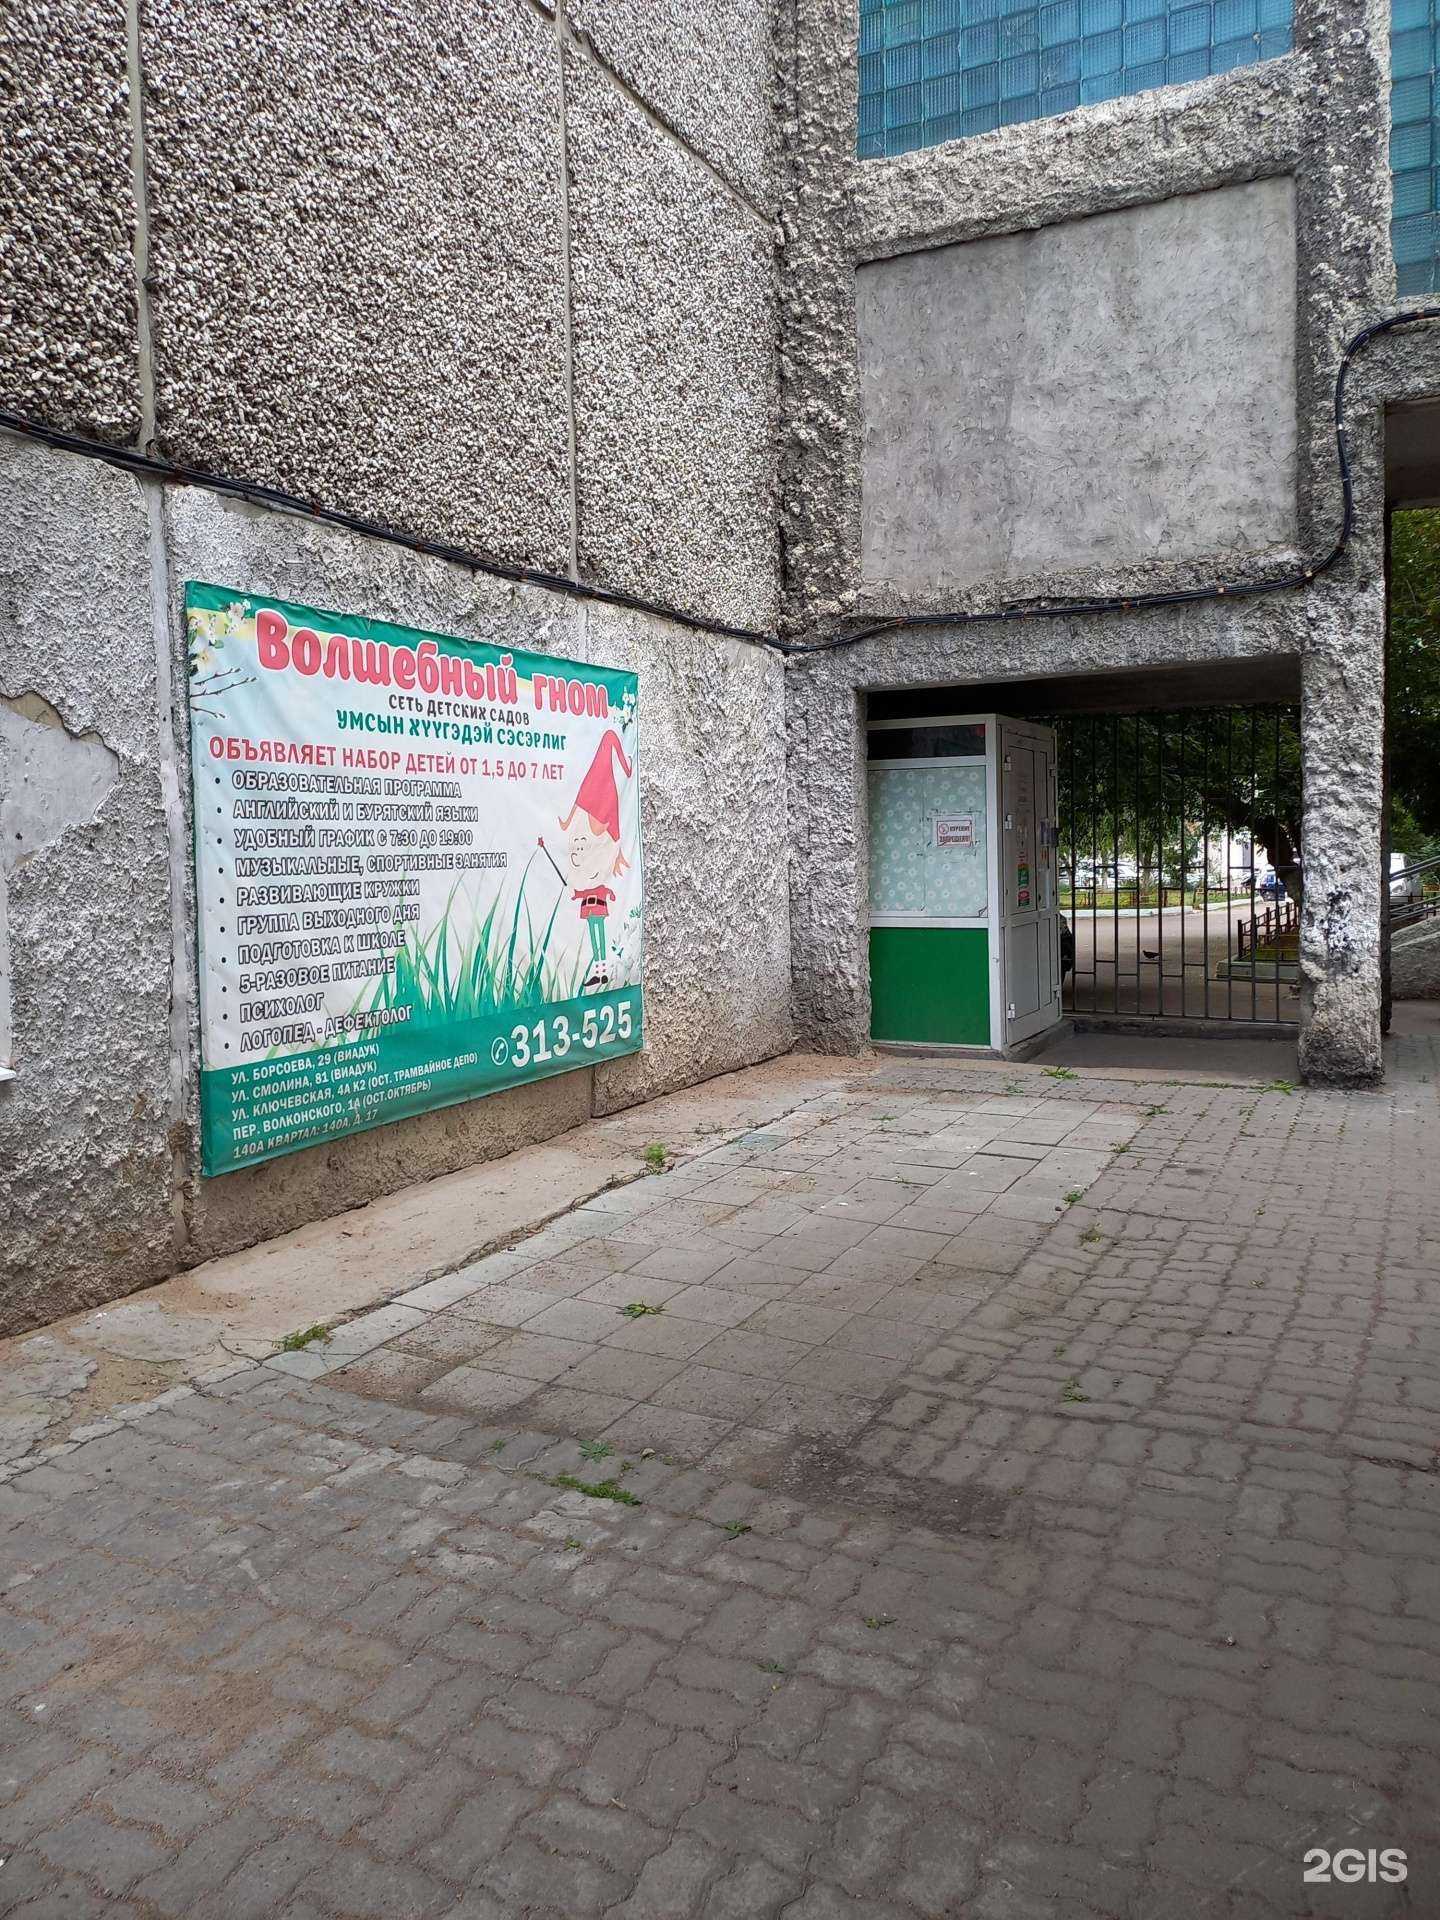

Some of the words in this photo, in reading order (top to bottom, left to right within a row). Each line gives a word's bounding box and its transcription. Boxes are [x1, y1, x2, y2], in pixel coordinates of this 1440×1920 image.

[255, 608, 518, 705] Волшебный
[532, 672, 609, 720] гном
[336, 709, 404, 735] УМСЫН
[497, 728, 566, 751] СЭСЭРЛИГ
[389, 694, 423, 712] СЕТЬ
[427, 699, 487, 721] ДЕТСКИХ
[490, 708, 530, 727] САДОВ
[209, 736, 336, 766] ОБЪЯВЛЯЕТ
[343, 748, 400, 770] НАБОР
[405, 752, 455, 774] ДЕТЕЙ
[460, 757, 477, 775] ОТ
[482, 758, 504, 779] 1,5
[508, 761, 526, 780] ДО
[531, 763, 538, 779] 7
[542, 764, 564, 780] ЛЕТ
[232, 770, 381, 795] ОБРАЗОВАТЕЛЬНАЯ
[384, 779, 462, 798] ПРОГРАММА
[233, 797, 340, 820] АНГЛИЙСКИЙ
[343, 803, 353, 820] И
[357, 802, 433, 821] БУРЯТСКИЙ
[436, 806, 479, 822] ЯЗЫКИ
[233, 825, 315, 851] УДОБНЫЙ
[319, 829, 374, 847] ГРАФИК
[377, 829, 387, 846] С
[389, 829, 418, 846] 7:30
[420, 829, 437, 848] ДО
[440, 829, 473, 846] 19:00
[235, 855, 363, 877] МУЗЫКАЛЬНЫЕ,
[366, 853, 454, 872] СПОРТИВНЫЕ
[456, 852, 507, 869] ЗАНЯТИЯ
[237, 882, 362, 906] РАЗВИВАЮЩИЕ
[364, 879, 420, 898] КРУЖКИ
[238, 913, 299, 935] ГРУППА
[302, 906, 390, 930] ВЫХОДНОГО
[393, 904, 420, 924] ДНЯ
[238, 936, 341, 965] ПОДГОТОВКА
[343, 934, 354, 952] К
[357, 930, 406, 951] ШКОЛЕ
[239, 965, 329, 993] 5-РАЗОВОЕ
[332, 957, 395, 981] ПИТАНИЕ
[240, 992, 324, 1022] ПСИХОЛОГ
[240, 1022, 316, 1052] ЛОГОПЕД
[324, 1005, 412, 1039] ДЕФЕКТОЛОГ
[510, 1000, 632, 1068] 313-525
[231, 1072, 249, 1085] УЛ.
[252, 1056, 315, 1081] БОРСОЕВА,
[317, 1053, 330, 1066] 29
[333, 1043, 380, 1065] (ВИАДУК)
[231, 1091, 249, 1103] УЛ.
[252, 1075, 312, 1099] СМОЛИНА,
[315, 1072, 329, 1085] 81
[331, 1061, 377, 1083] (ВИАДУК)
[231, 1109, 249, 1122] УЛ.
[253, 1087, 334, 1117] КЛЮЧЕВСКАЯ,
[337, 1083, 350, 1096] 4А
[353, 1080, 366, 1093] К2
[368, 1074, 392, 1091] (ОСТ.
[394, 1058, 452, 1082] ТРАМВАЙНОЕ
[453, 1052, 478, 1069] ДЕПО)
[233, 1127, 260, 1141] ПЕР.
[263, 1103, 345, 1133] ВОЛКОНСКОГО,
[347, 1098, 360, 1111] 1А
[363, 1079, 431, 1108] (ОСТ.ОКТЯБРЬ)
[233, 1143, 264, 1159] 140А
[267, 1127, 320, 1149] КВАРТАЛ:
[366, 1109, 378, 1121] 17
